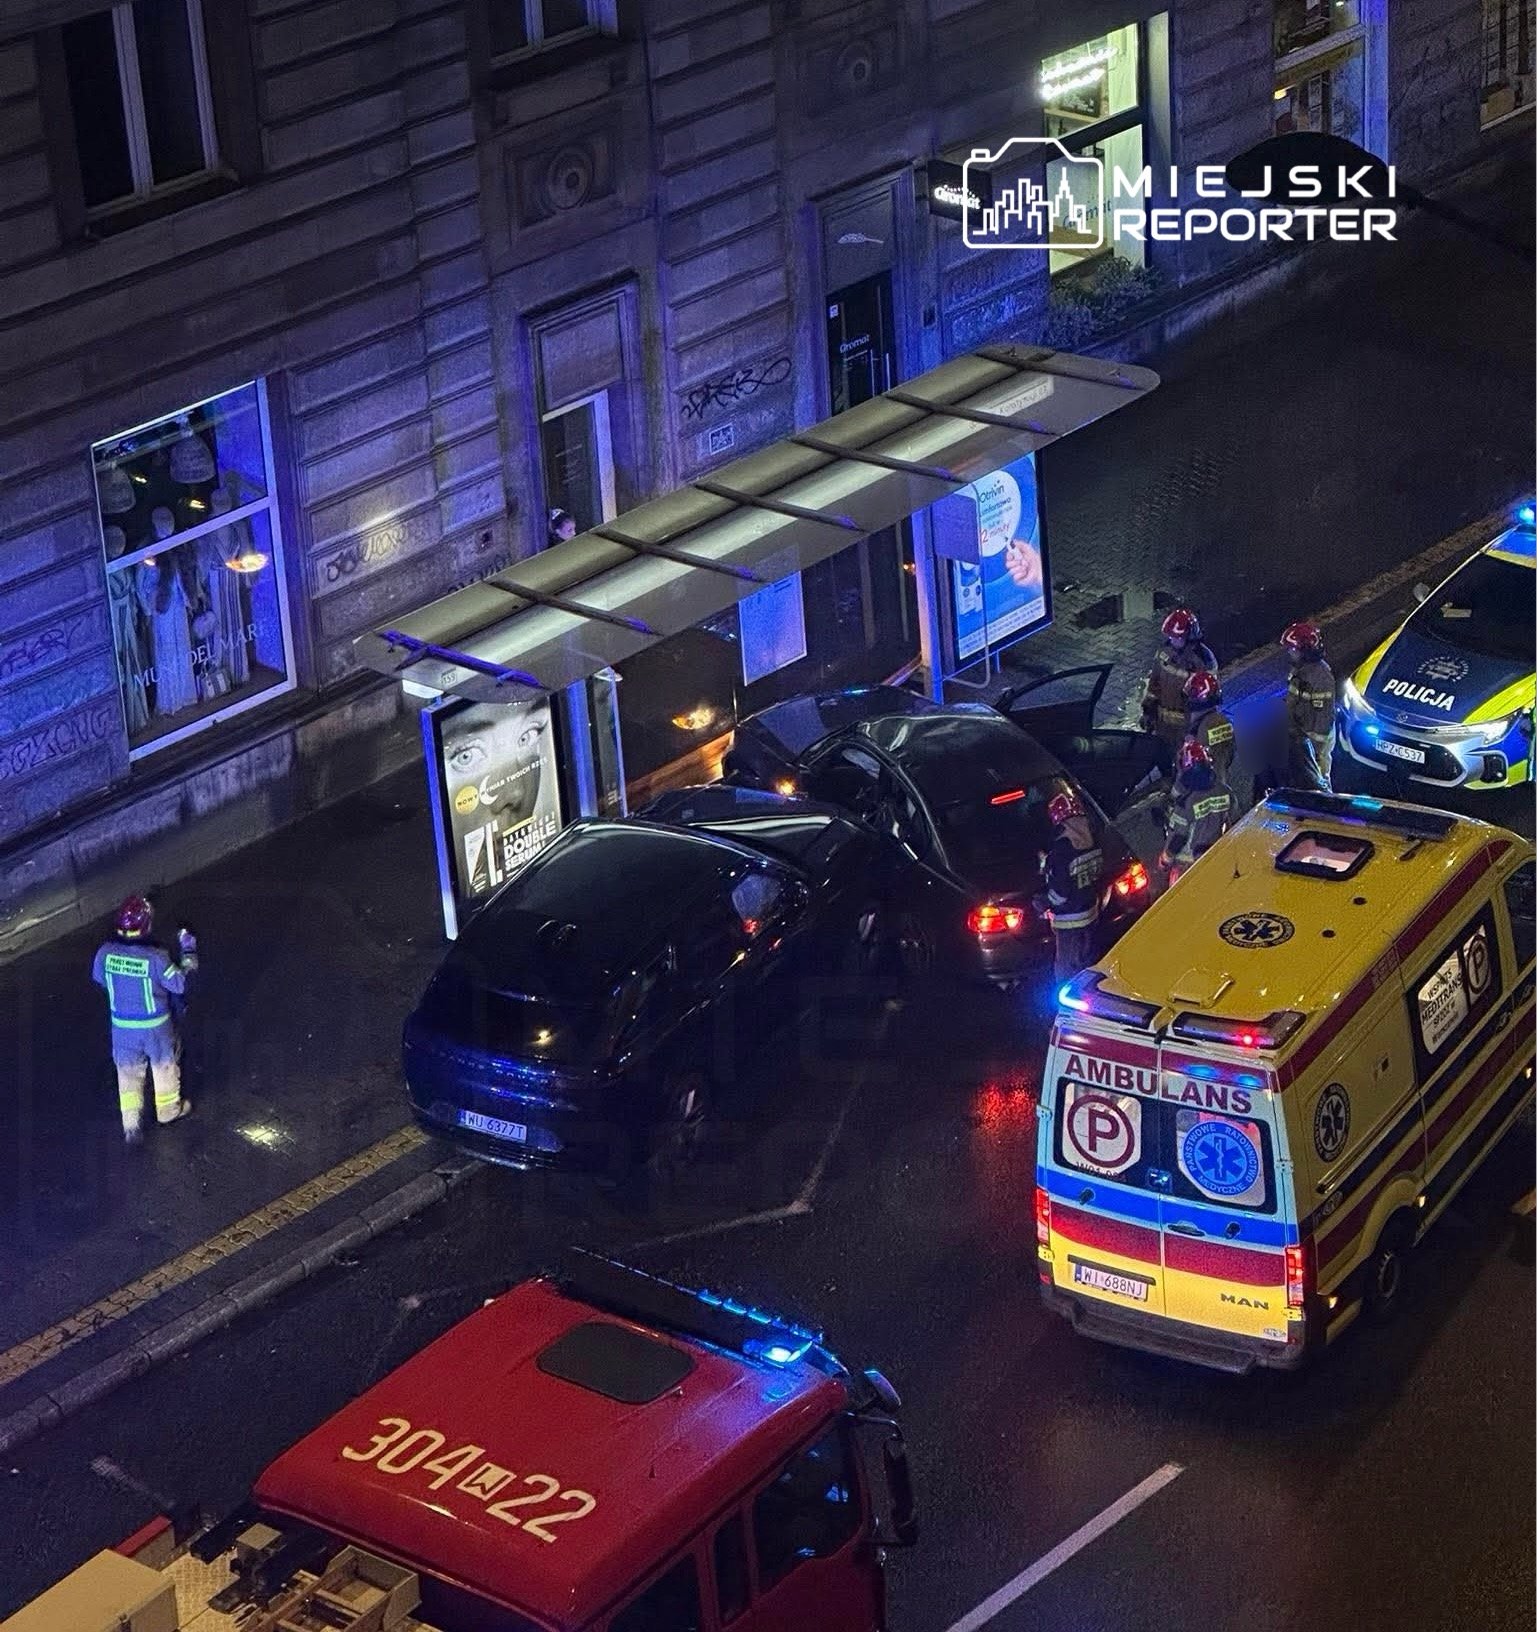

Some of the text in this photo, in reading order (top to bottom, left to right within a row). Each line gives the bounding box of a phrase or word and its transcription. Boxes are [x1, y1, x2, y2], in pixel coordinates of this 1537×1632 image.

[219, 622, 258, 651] MAR
[1382, 678, 1455, 711] POLICJA
[504, 820, 557, 860] DOUBLE
[1473, 943, 1485, 985] P
[1064, 1054, 1253, 1114] AMBULANS
[468, 1112, 524, 1138] WU 6377T
[1087, 1107, 1121, 1152] P
[1224, 1126, 1258, 1184] RATOWNICTWO
[1199, 1175, 1247, 1194] MEDYCZNE
[1084, 1269, 1143, 1297] WI 688NJ
[1220, 1293, 1269, 1310] MAN
[341, 1417, 486, 1490] 304
[485, 1474, 597, 1543] 22
